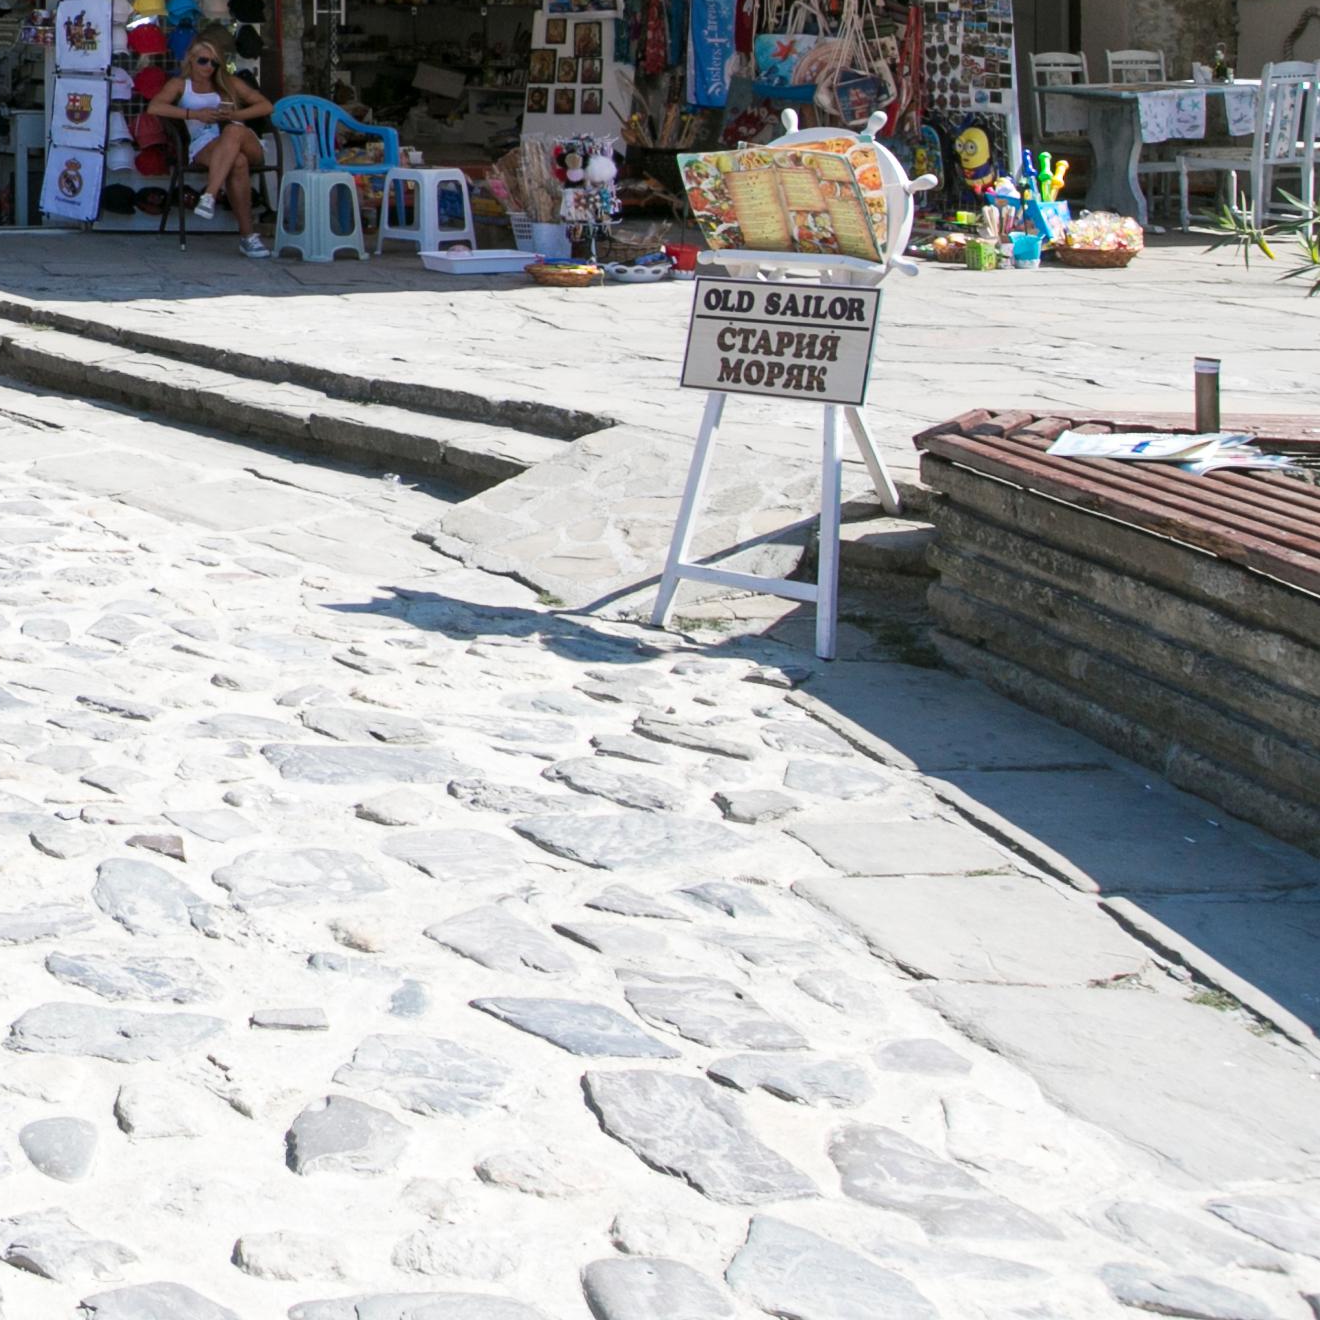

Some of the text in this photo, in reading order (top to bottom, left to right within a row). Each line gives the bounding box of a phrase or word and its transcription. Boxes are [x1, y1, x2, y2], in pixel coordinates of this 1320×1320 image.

[703, 287, 866, 322] OLD SAILOR
[716, 326, 842, 362] СТАРИЯ
[716, 356, 828, 393] МОРЯК
